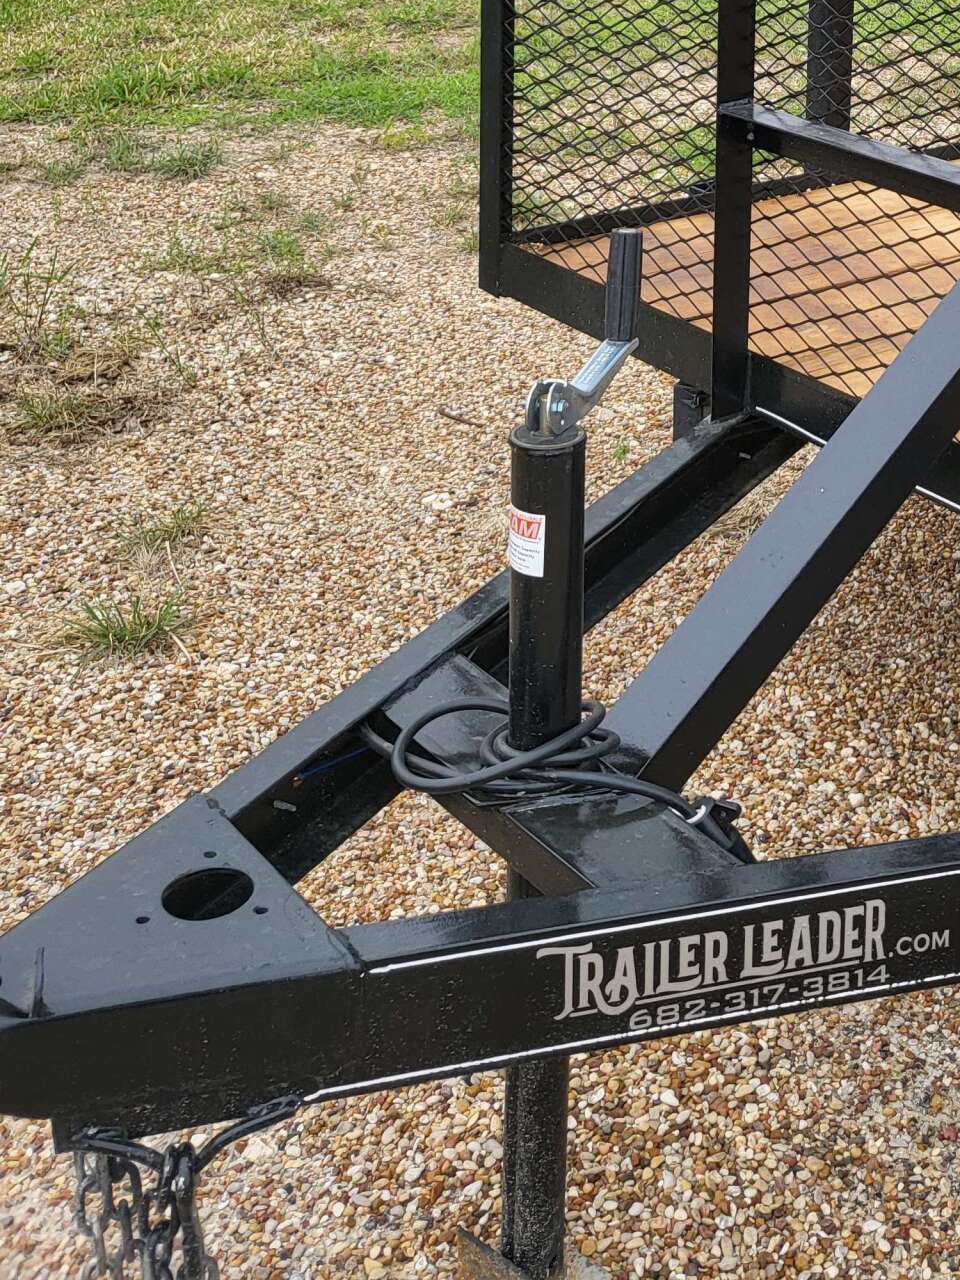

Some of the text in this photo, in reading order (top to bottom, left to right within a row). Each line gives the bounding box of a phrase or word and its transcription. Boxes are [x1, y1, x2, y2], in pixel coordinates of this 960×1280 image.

[510, 516, 539, 538] AM
[536, 930, 729, 1021] TRAILER
[740, 898, 887, 978] LEADER
[628, 964, 891, 1031] 682-317-3814
